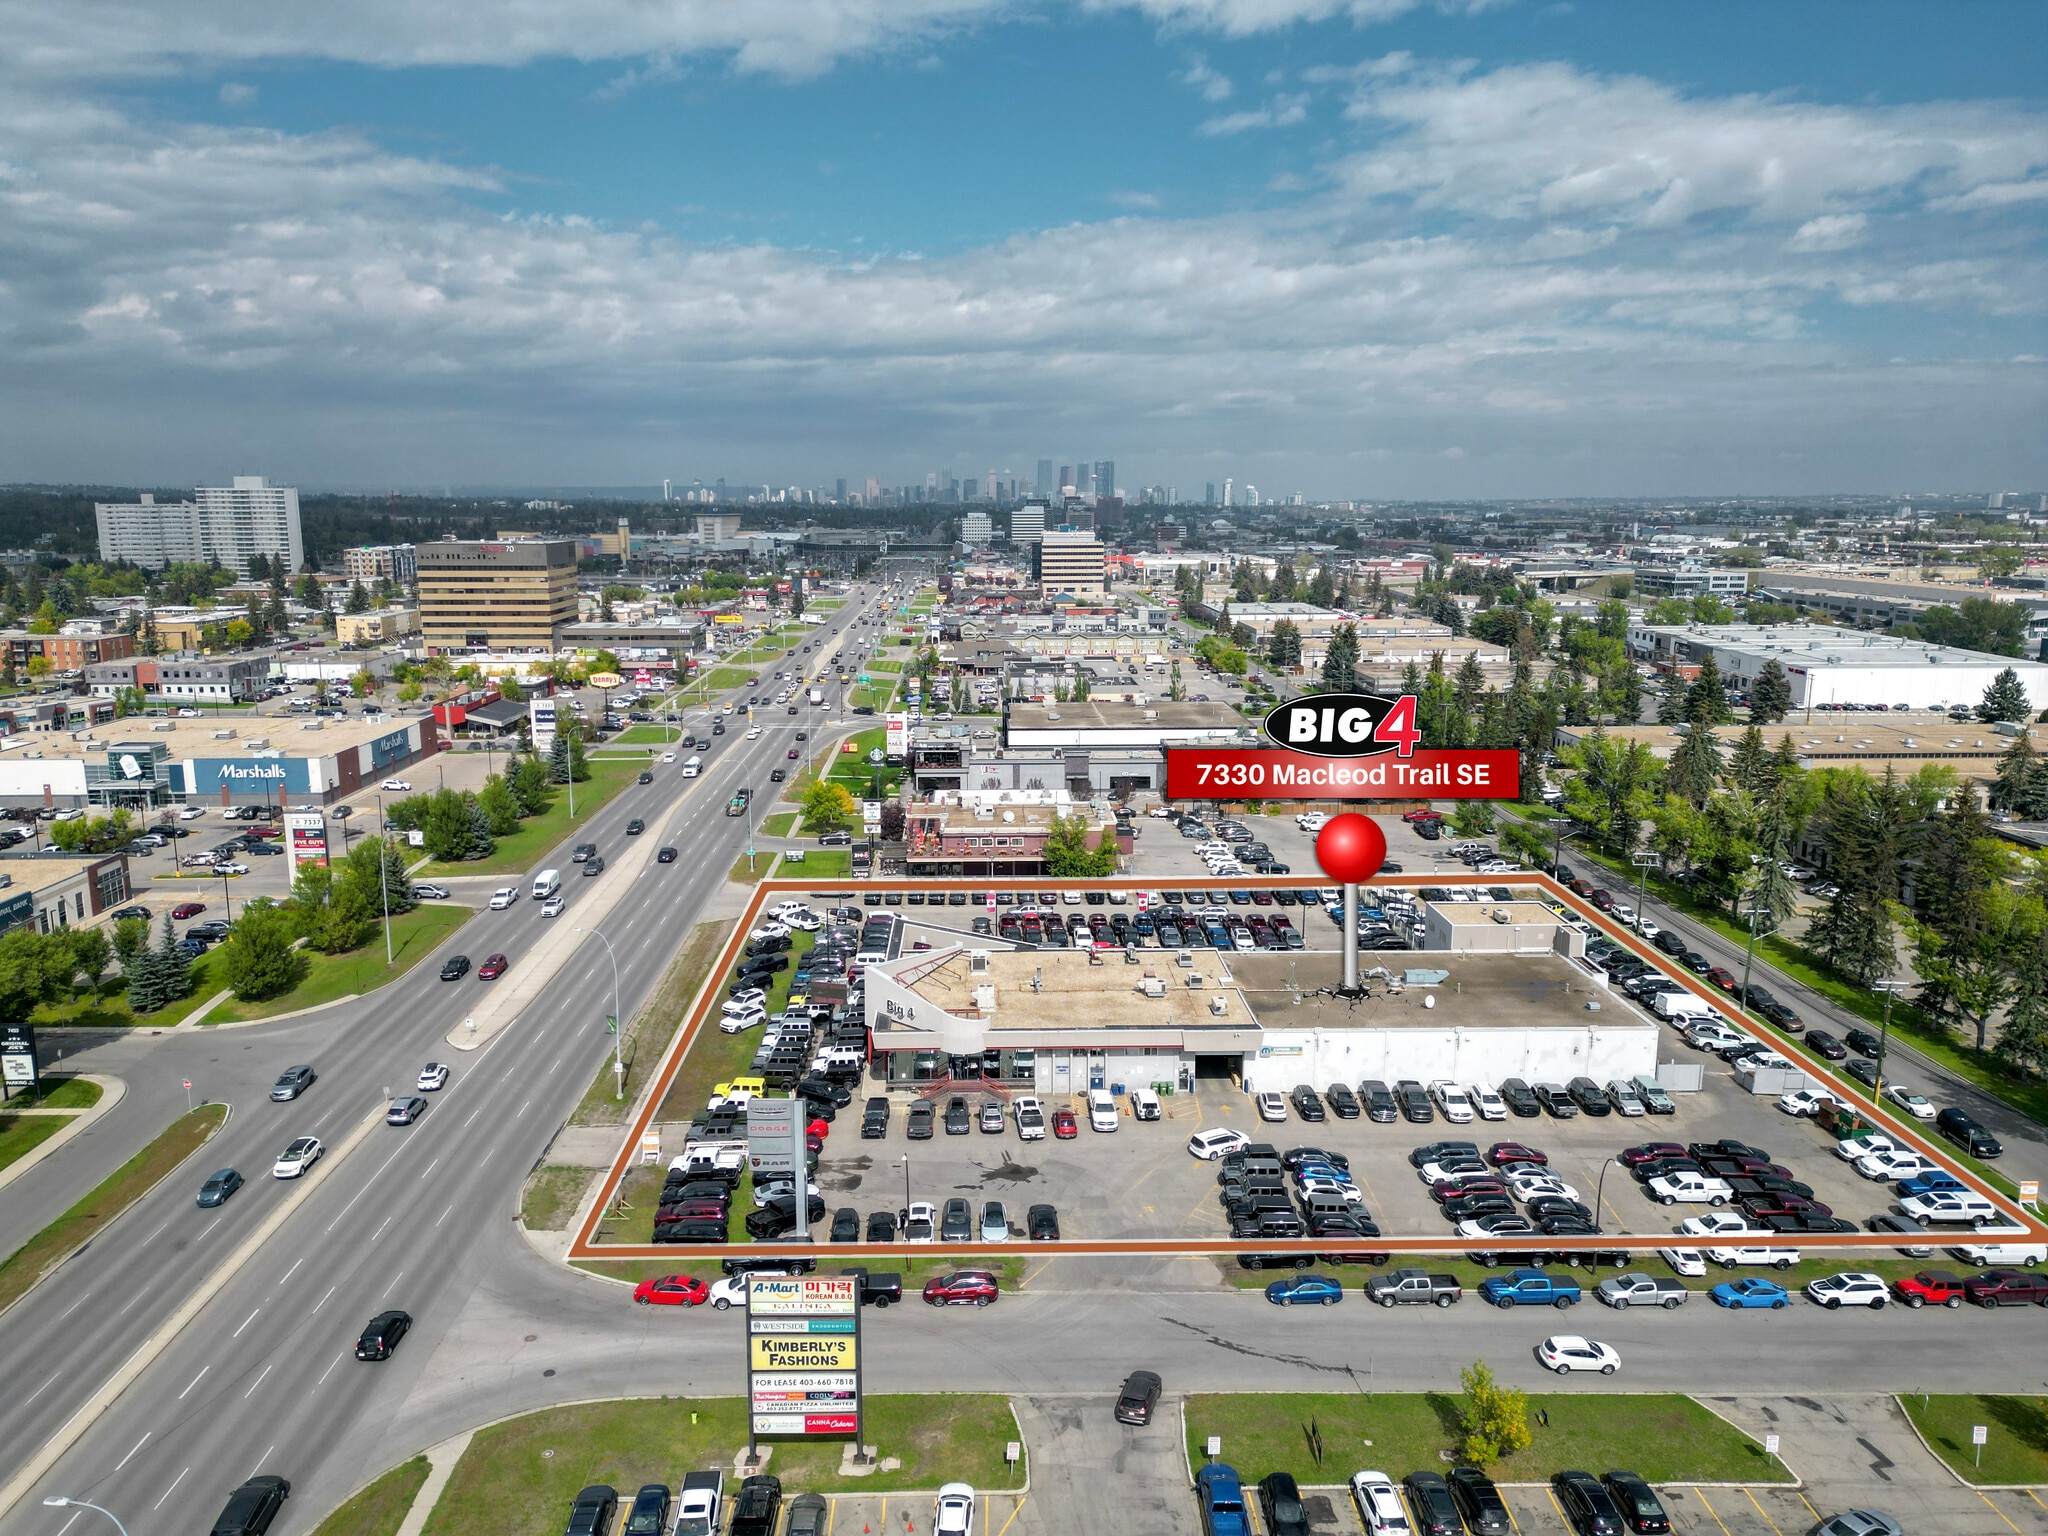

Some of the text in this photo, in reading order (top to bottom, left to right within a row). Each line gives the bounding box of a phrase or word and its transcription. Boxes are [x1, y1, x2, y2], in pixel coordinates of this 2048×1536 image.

[380, 734, 404, 752] Marshalls
[218, 764, 286, 778] Marshalls
[13, 899, 28, 911] BANK
[886, 1000, 916, 1020] Big 4
[805, 1282, 852, 1293] 미가락
[762, 1340, 846, 1352] KIMBERLY'S
[770, 1354, 838, 1366] FASHIONS
